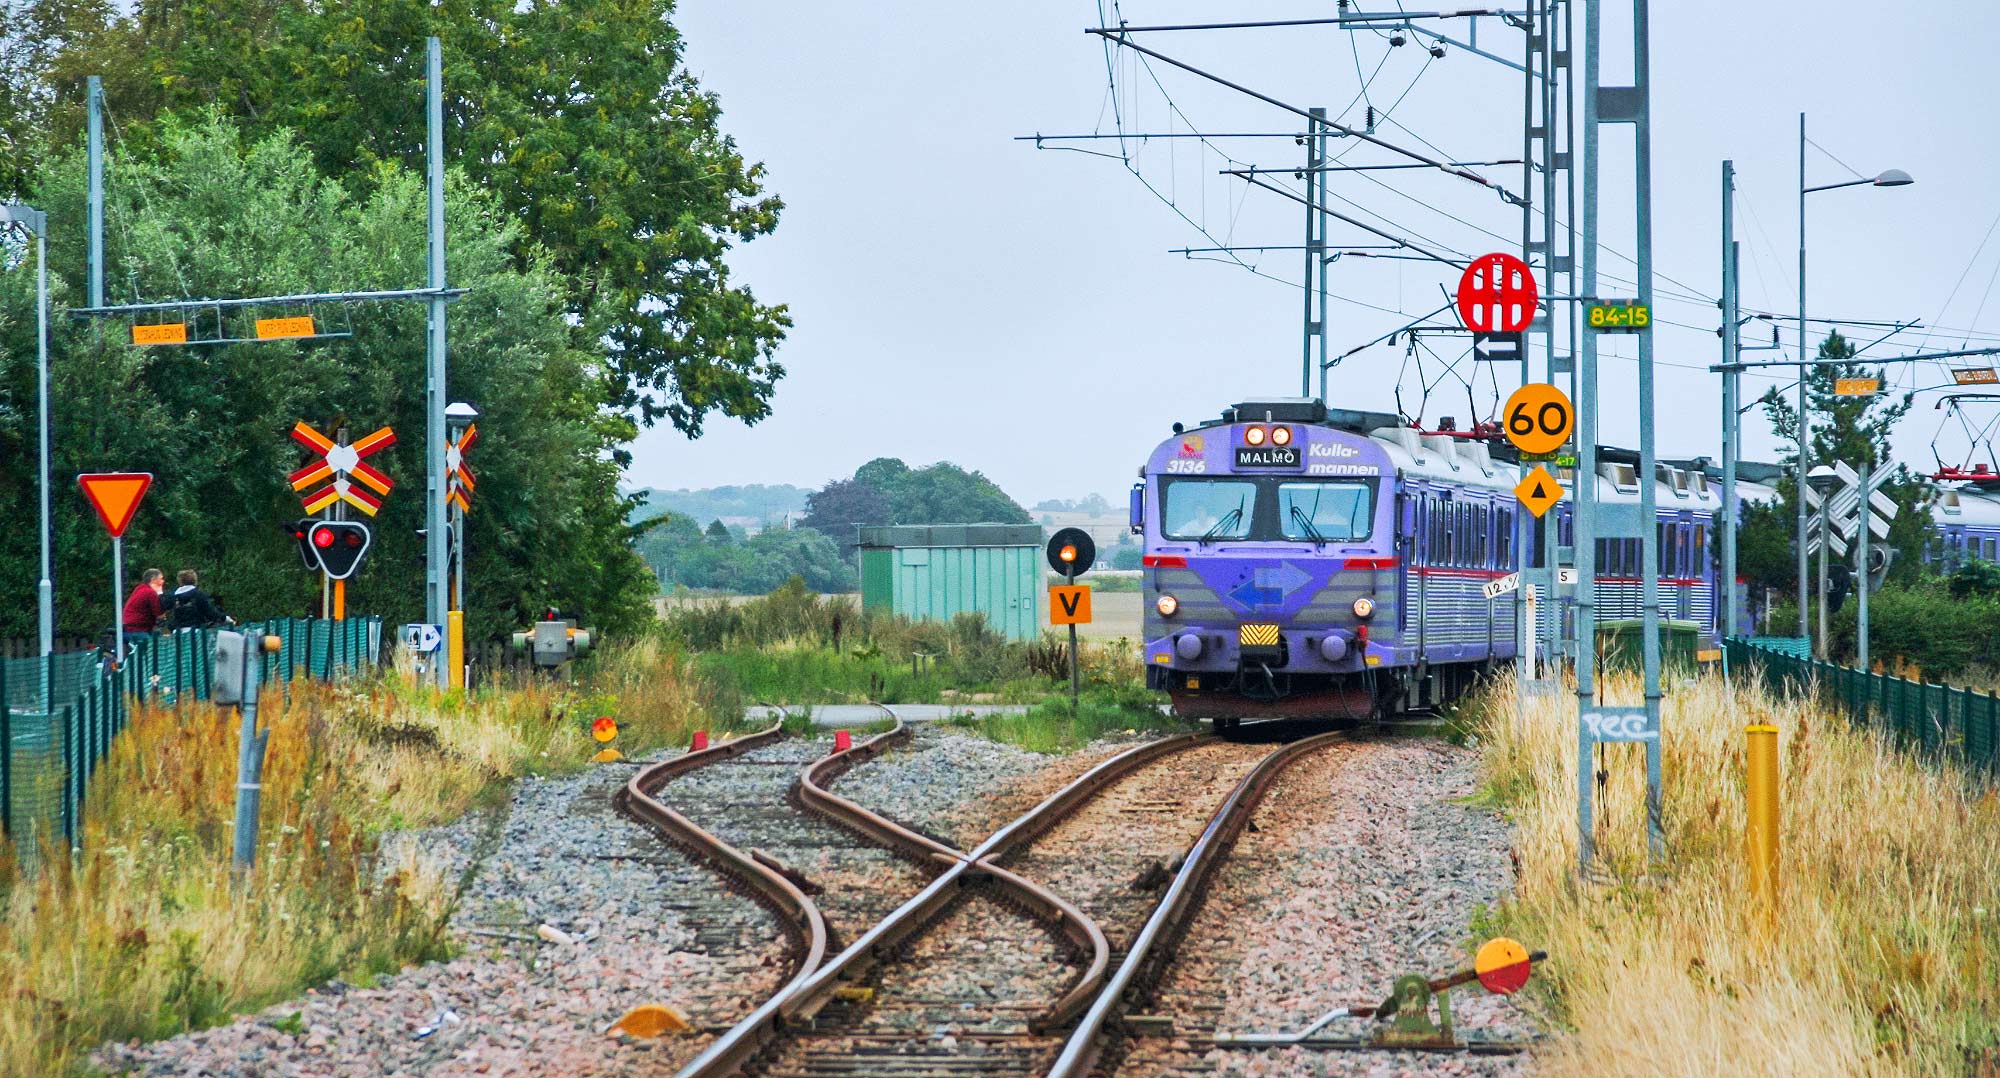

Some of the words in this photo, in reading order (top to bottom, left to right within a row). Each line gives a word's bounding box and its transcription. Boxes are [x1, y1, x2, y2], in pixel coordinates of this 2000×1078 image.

[1591, 307, 1648, 325] 84-15
[1509, 401, 1567, 436] 60
[1309, 443, 1359, 457] Kulla-
[1166, 459, 1206, 473] 3136
[1309, 464, 1379, 476] mannen
[1560, 571, 1568, 582] 5
[1059, 591, 1082, 617] V
